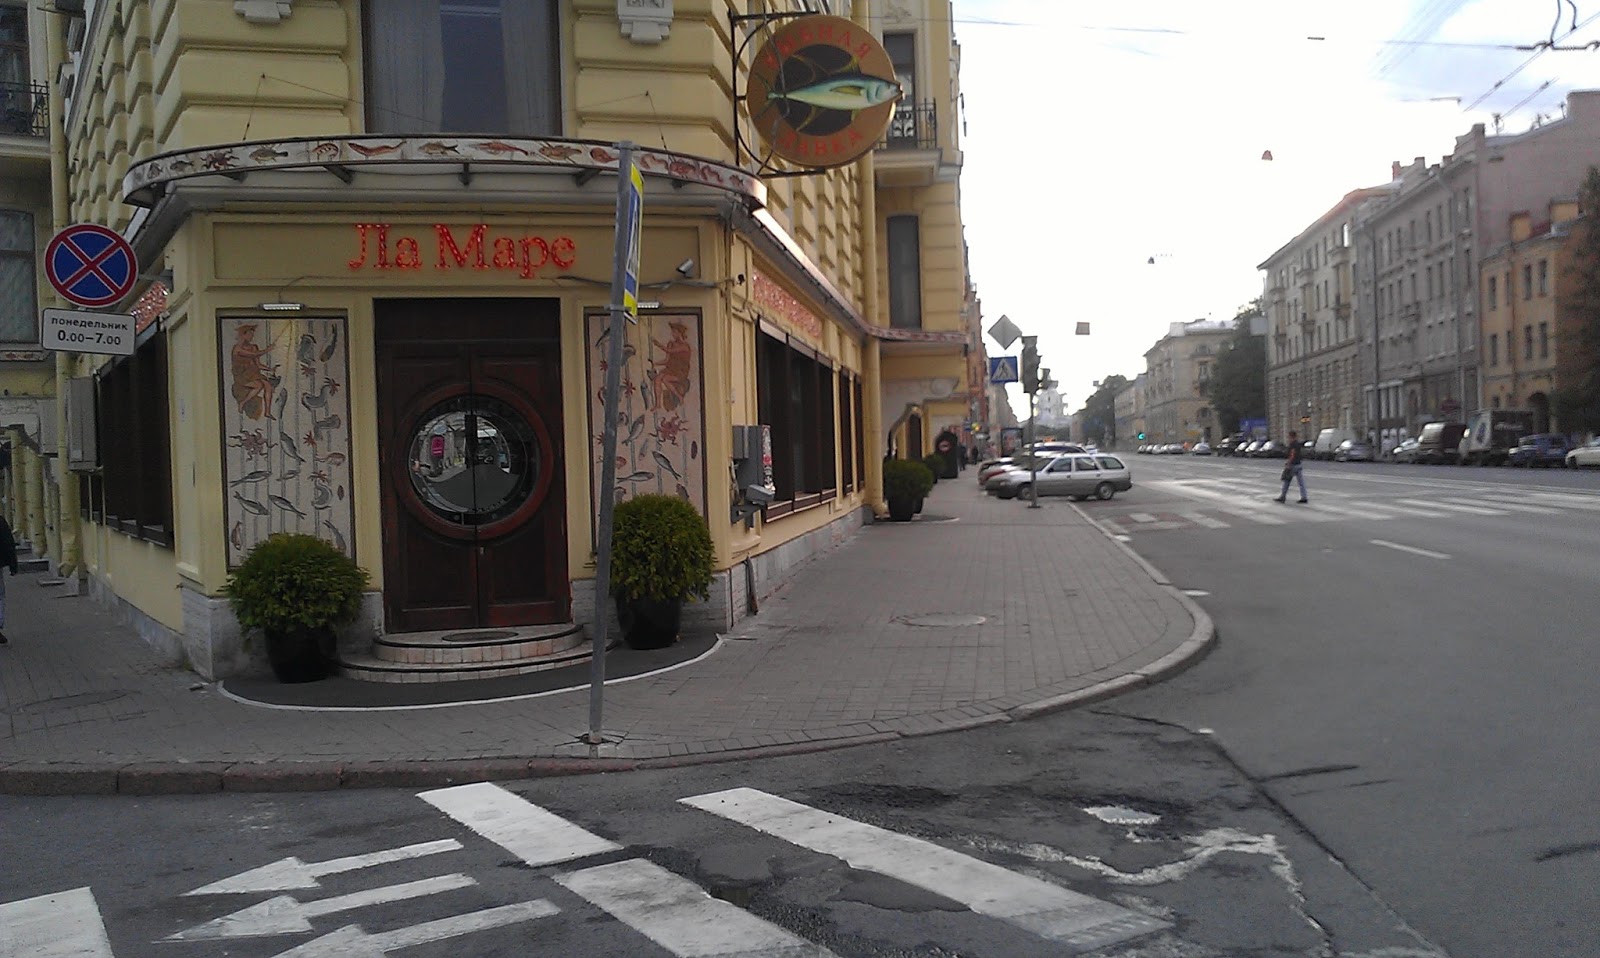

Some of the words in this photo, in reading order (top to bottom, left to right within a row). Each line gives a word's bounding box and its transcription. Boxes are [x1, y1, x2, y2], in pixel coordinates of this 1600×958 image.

[349, 222, 422, 270] Ла
[433, 222, 576, 280] Маре
[51, 316, 129, 331] понедельник
